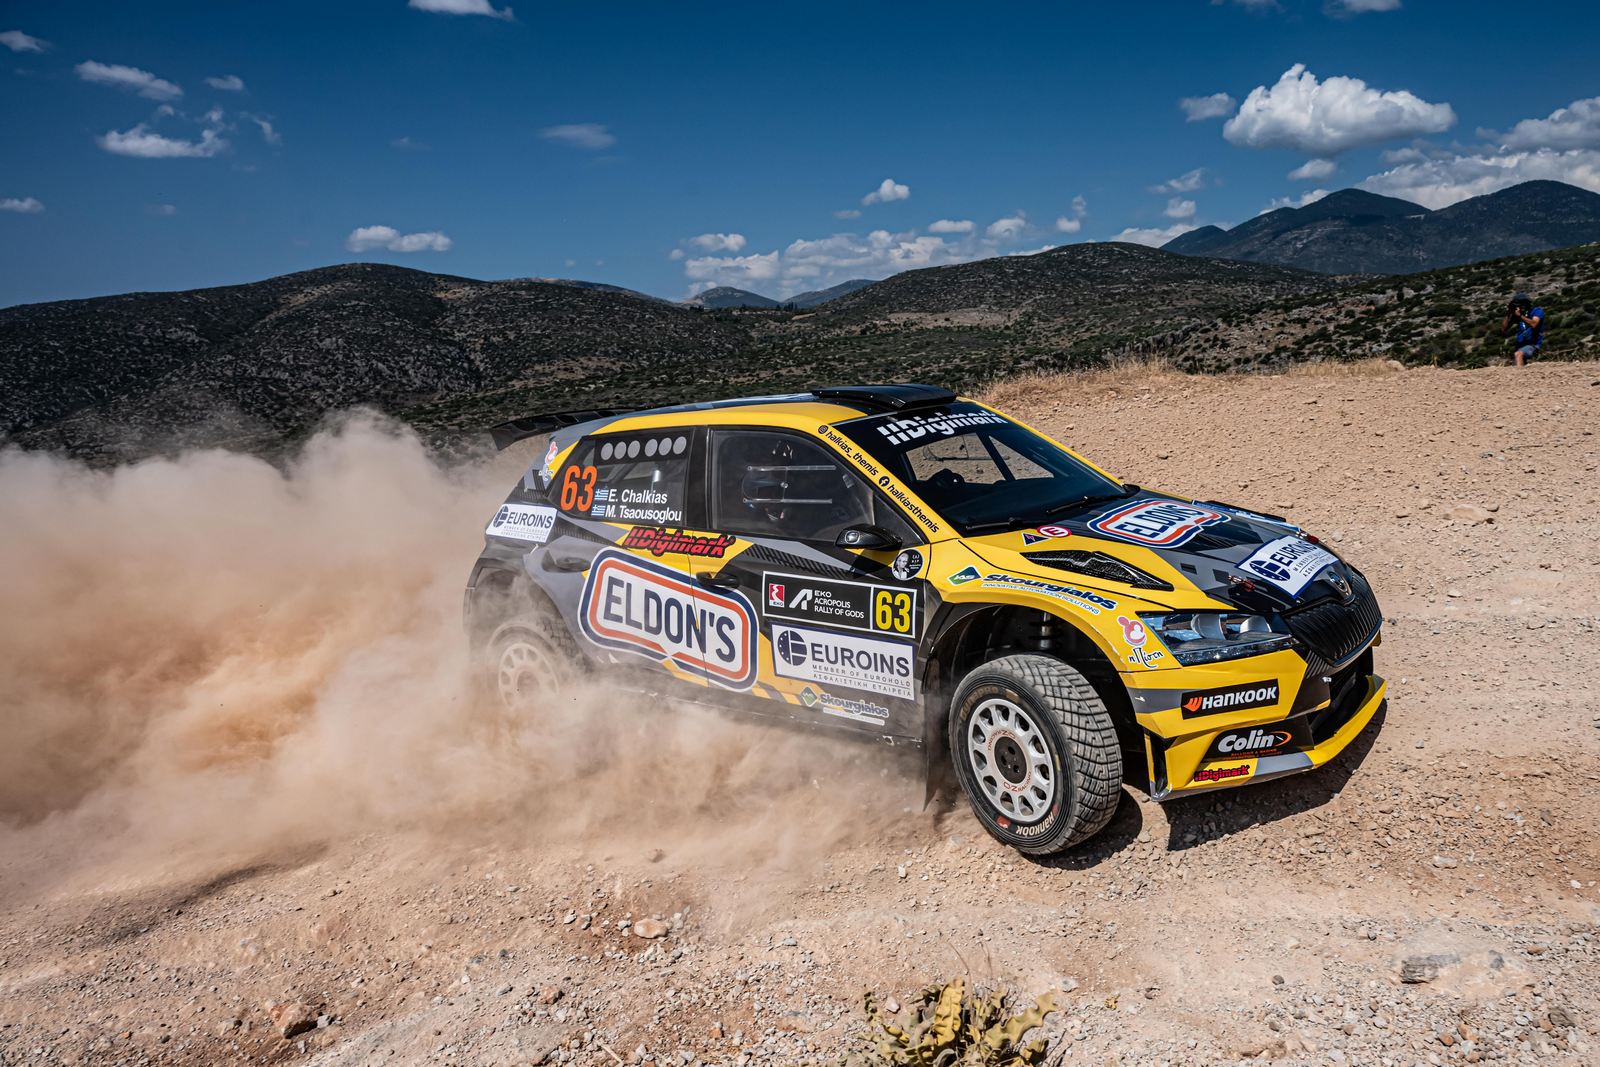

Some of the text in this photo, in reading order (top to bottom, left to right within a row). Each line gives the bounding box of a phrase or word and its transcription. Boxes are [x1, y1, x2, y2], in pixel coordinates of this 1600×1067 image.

[560, 464, 598, 512] 63
[608, 489, 668, 504] E. Chalkias
[605, 504, 682, 524] M. Tsaousoglou
[886, 483, 940, 534] halkiasthemis
[506, 511, 553, 529] EUROINS
[814, 589, 832, 599] EKO
[814, 597, 851, 609] ACROPOLIS
[983, 574, 1117, 610] Skourgialos
[814, 605, 865, 619] RALLY OF GODS
[875, 590, 911, 633] 63
[1062, 595, 1100, 615] SOLUTIONS
[603, 575, 736, 663] ELDON'S
[810, 642, 910, 678] EUROINS
[812, 664, 846, 675] MEMBER
[820, 693, 889, 717] Skourgialos
[1218, 729, 1275, 753] Colin
